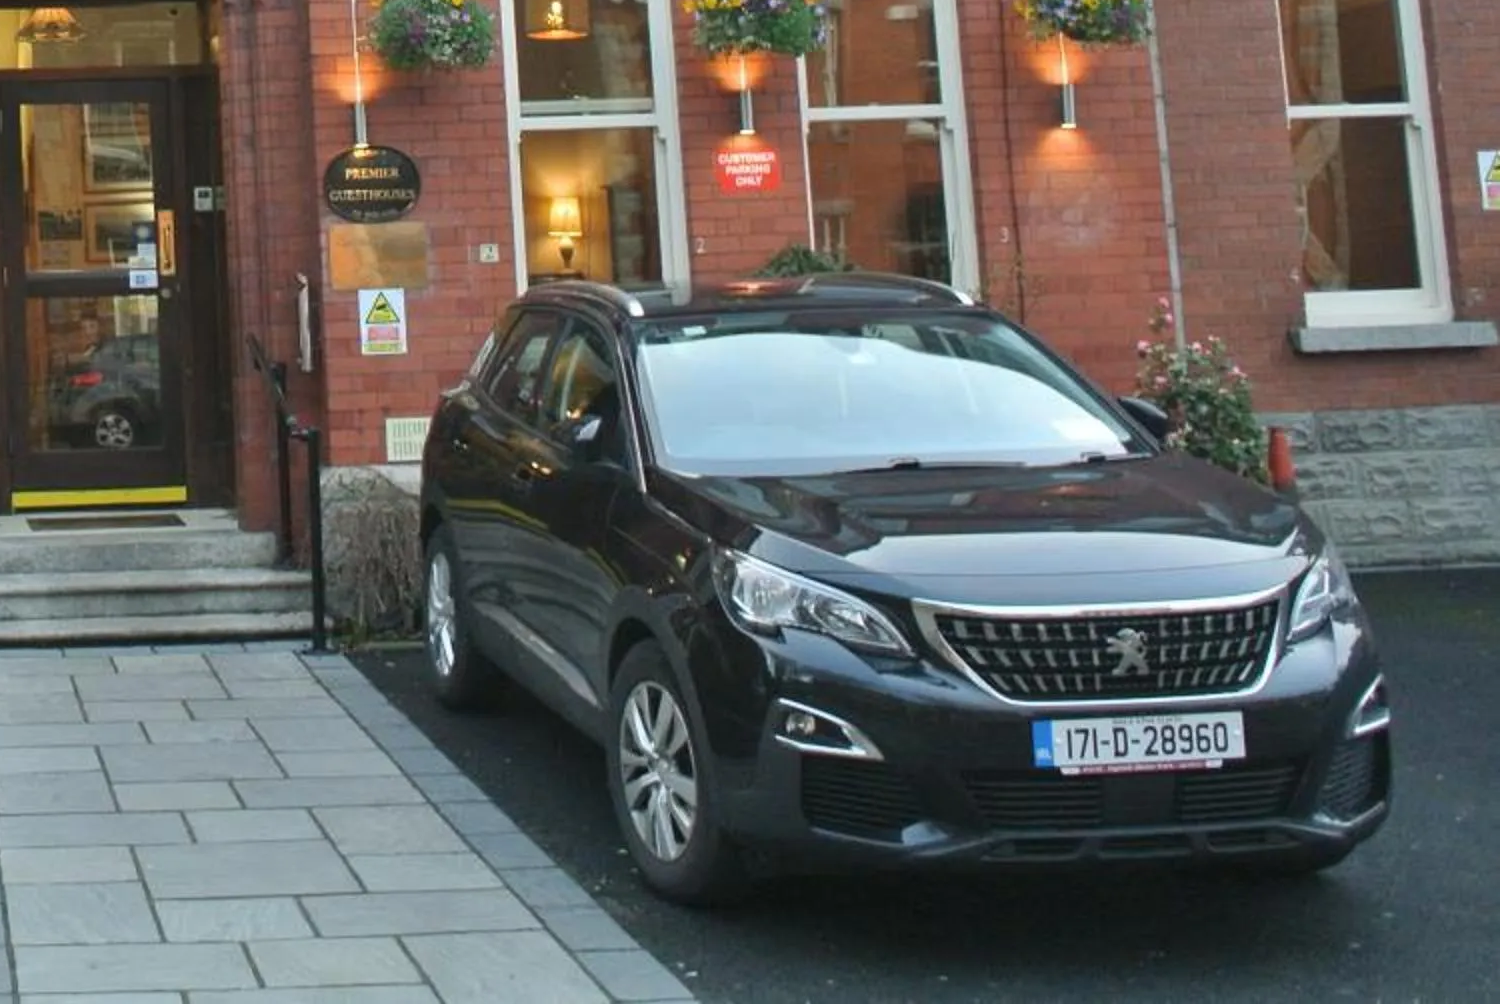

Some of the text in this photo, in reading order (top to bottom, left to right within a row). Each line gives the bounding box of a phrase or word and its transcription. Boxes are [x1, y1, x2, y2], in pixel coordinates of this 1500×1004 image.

[717, 151, 775, 164] CUSTOMER
[345, 167, 400, 180] PREMIER
[725, 164, 771, 176] PARKING
[735, 175, 763, 187] ONLY
[1000, 226, 1009, 243] 3
[1066, 722, 1229, 759] 171-D-28960
